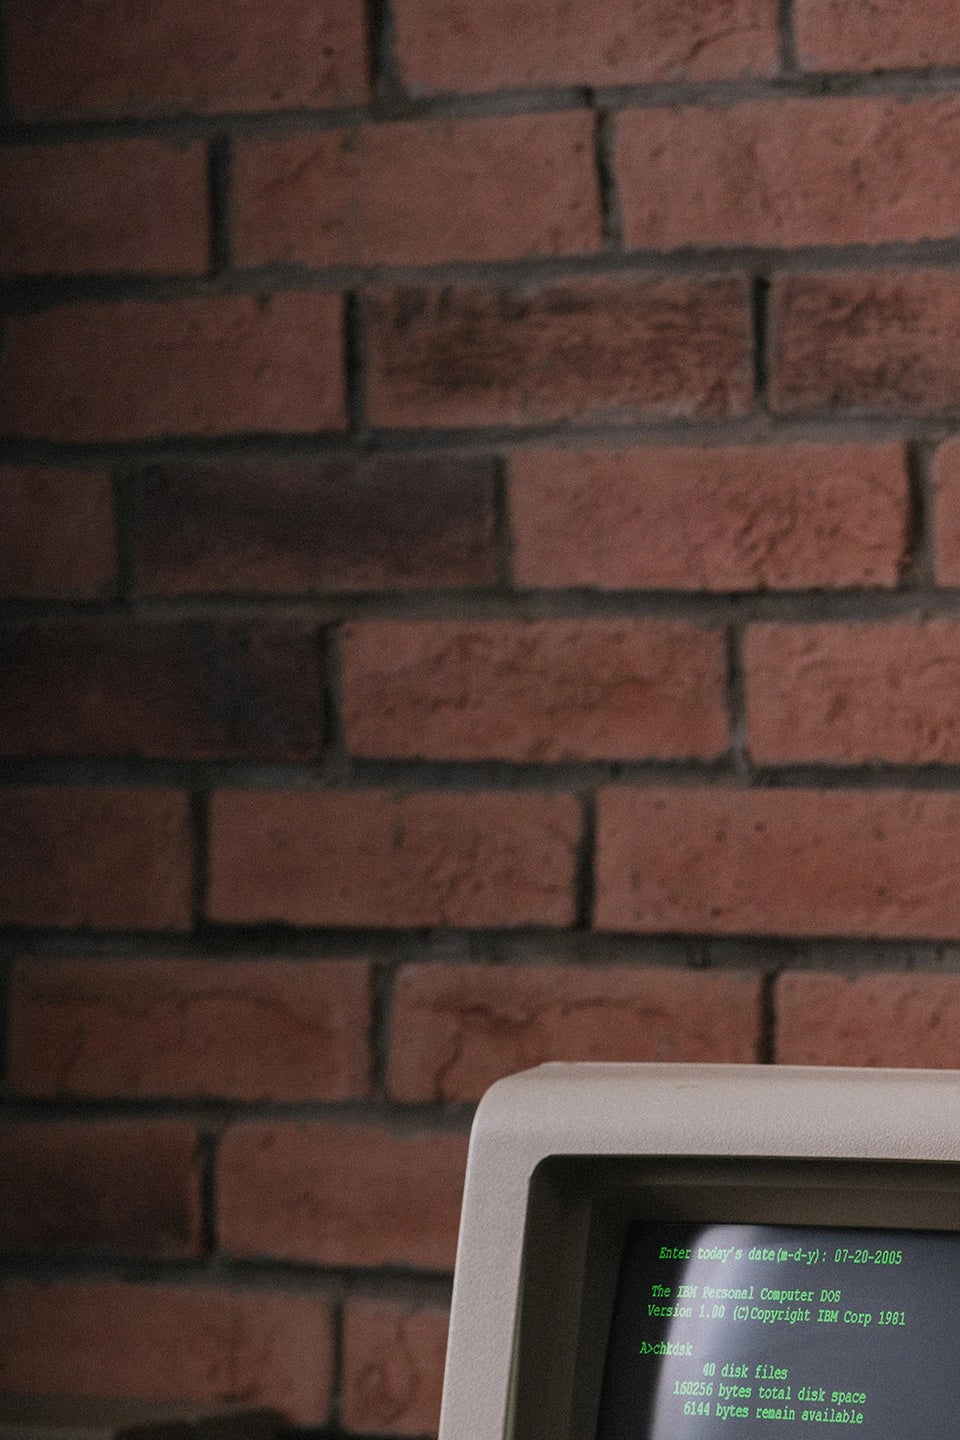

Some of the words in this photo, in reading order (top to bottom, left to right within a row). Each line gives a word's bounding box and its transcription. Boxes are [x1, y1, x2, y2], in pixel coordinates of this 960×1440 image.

[659, 1247, 692, 1260] Enter
[697, 1247, 743, 1263] today's
[834, 1249, 903, 1265] 07-20-2005
[651, 1284, 672, 1298] The
[675, 1285, 699, 1299] IBM
[702, 1286, 755, 1300] Personal
[760, 1287, 815, 1304] Computer
[820, 1289, 841, 1303] DOS
[647, 1303, 692, 1318] Version
[697, 1304, 726, 1319] 1.00
[733, 1306, 811, 1325] (C)Copyright
[817, 1309, 840, 1323] IBM
[843, 1310, 872, 1327] Corp
[878, 1311, 906, 1326] 1981
[640, 1341, 694, 1356] A>chkdsk
[702, 1362, 716, 1377] 40
[721, 1363, 750, 1379] disk
[754, 1364, 789, 1380] files
[672, 1381, 714, 1397] 160256
[718, 1383, 752, 1400] bytes
[758, 1386, 792, 1400] total
[797, 1387, 826, 1402] disk
[831, 1391, 867, 1406] space
[683, 1401, 711, 1416] 6144
[715, 1403, 750, 1420] bytes
[755, 1405, 796, 1420] remain
[801, 1408, 864, 1425] available
